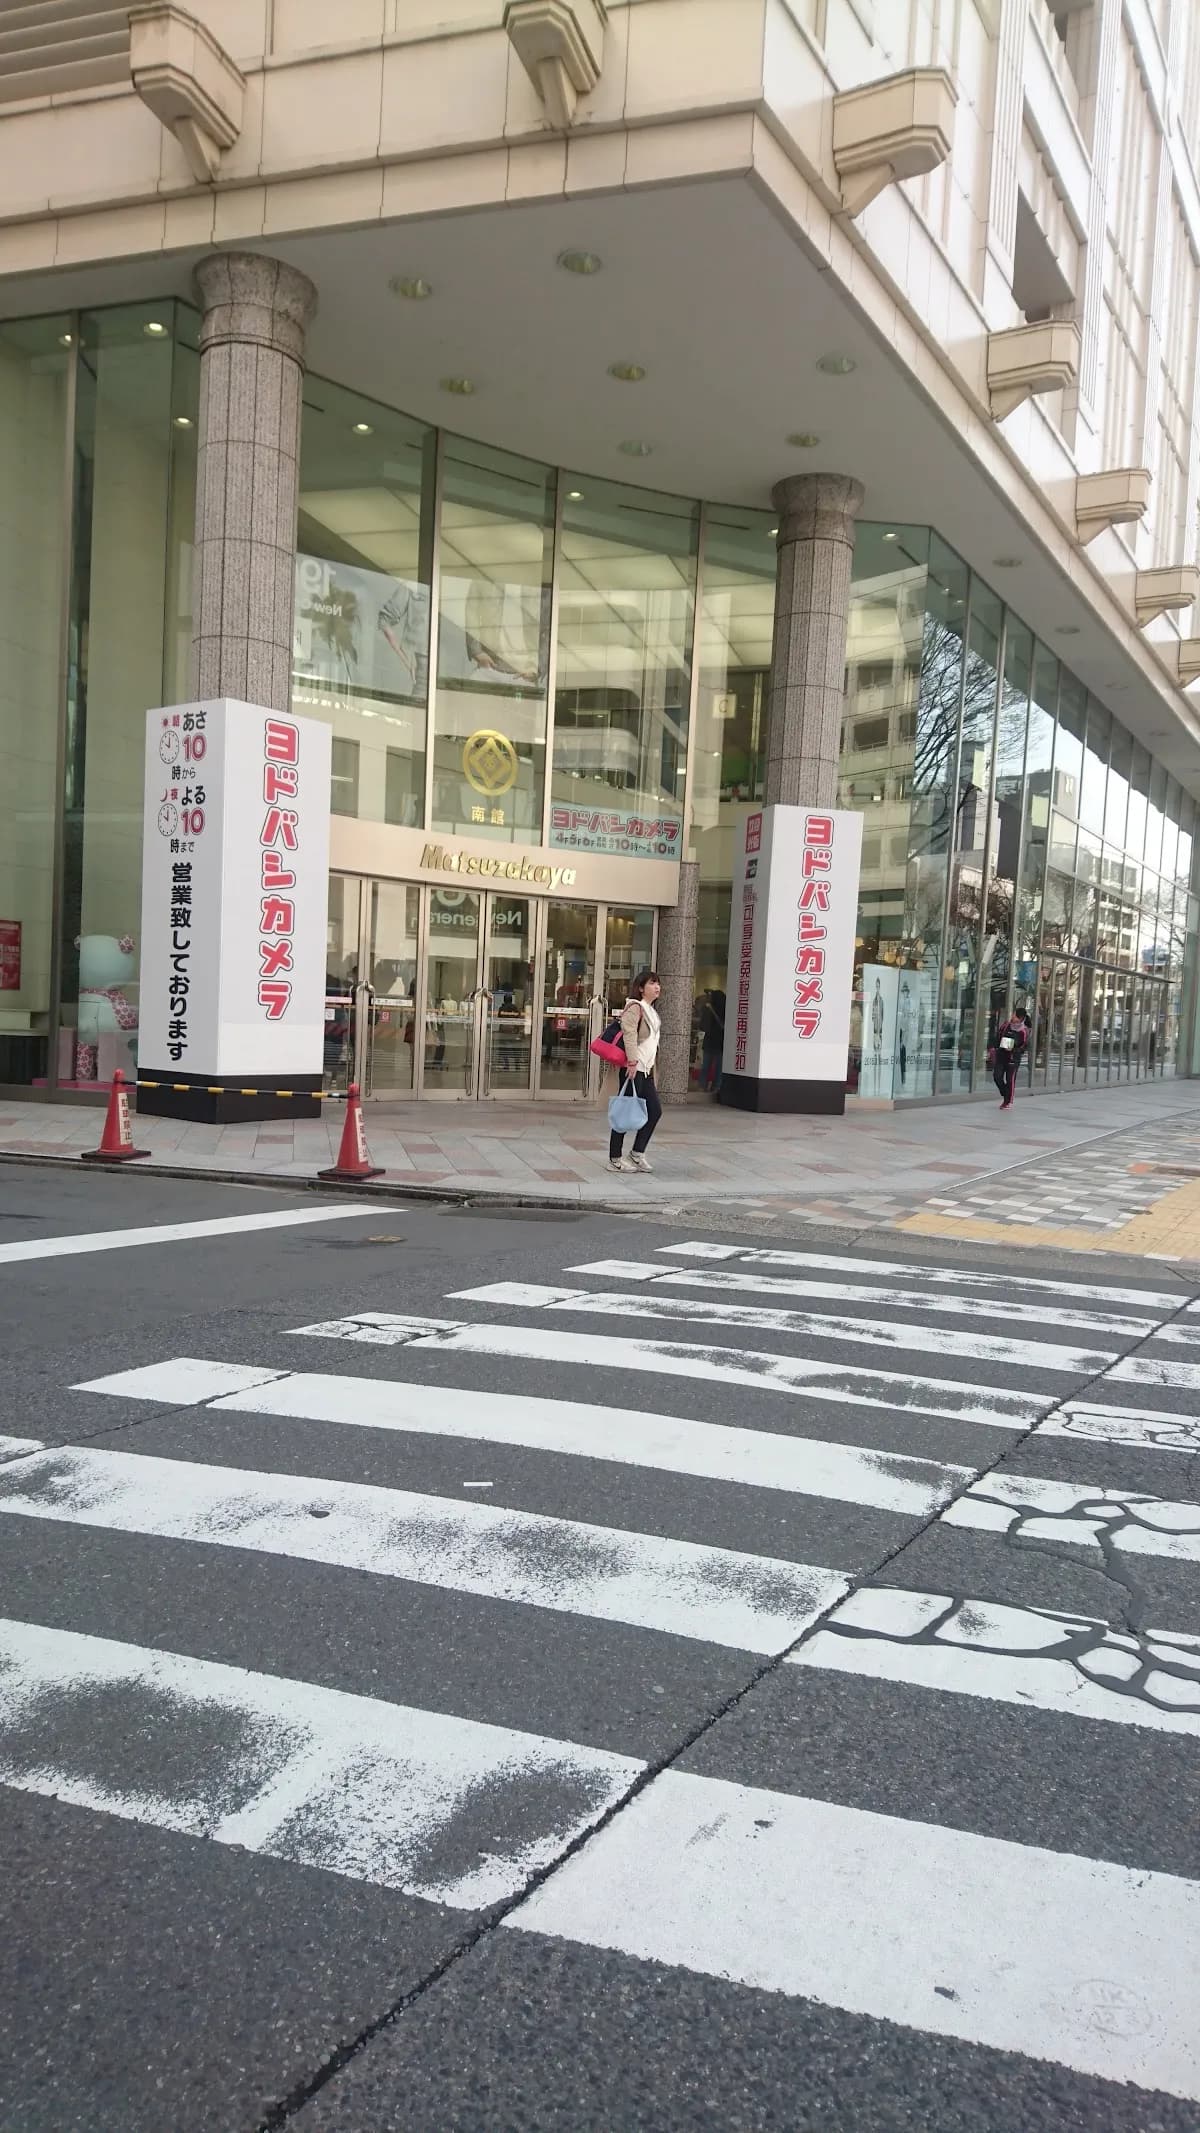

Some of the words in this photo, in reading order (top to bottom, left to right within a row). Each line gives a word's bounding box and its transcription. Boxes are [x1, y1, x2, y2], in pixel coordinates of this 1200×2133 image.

[182, 710, 207, 731] あさ
[182, 732, 207, 762] 10
[172, 765, 196, 780] 時から
[181, 785, 206, 806] よる
[181, 806, 206, 837] 10
[471, 805, 505, 825] 南館
[551, 807, 680, 841] ヨドバシカメラ
[170, 838, 196, 853] 時まで
[257, 717, 300, 1021] ヨドバシカメラ
[419, 843, 577, 890] Matsuzakaya
[791, 813, 834, 1039] ヨドバシカメラ
[166, 861, 193, 1062] 営業致しております
